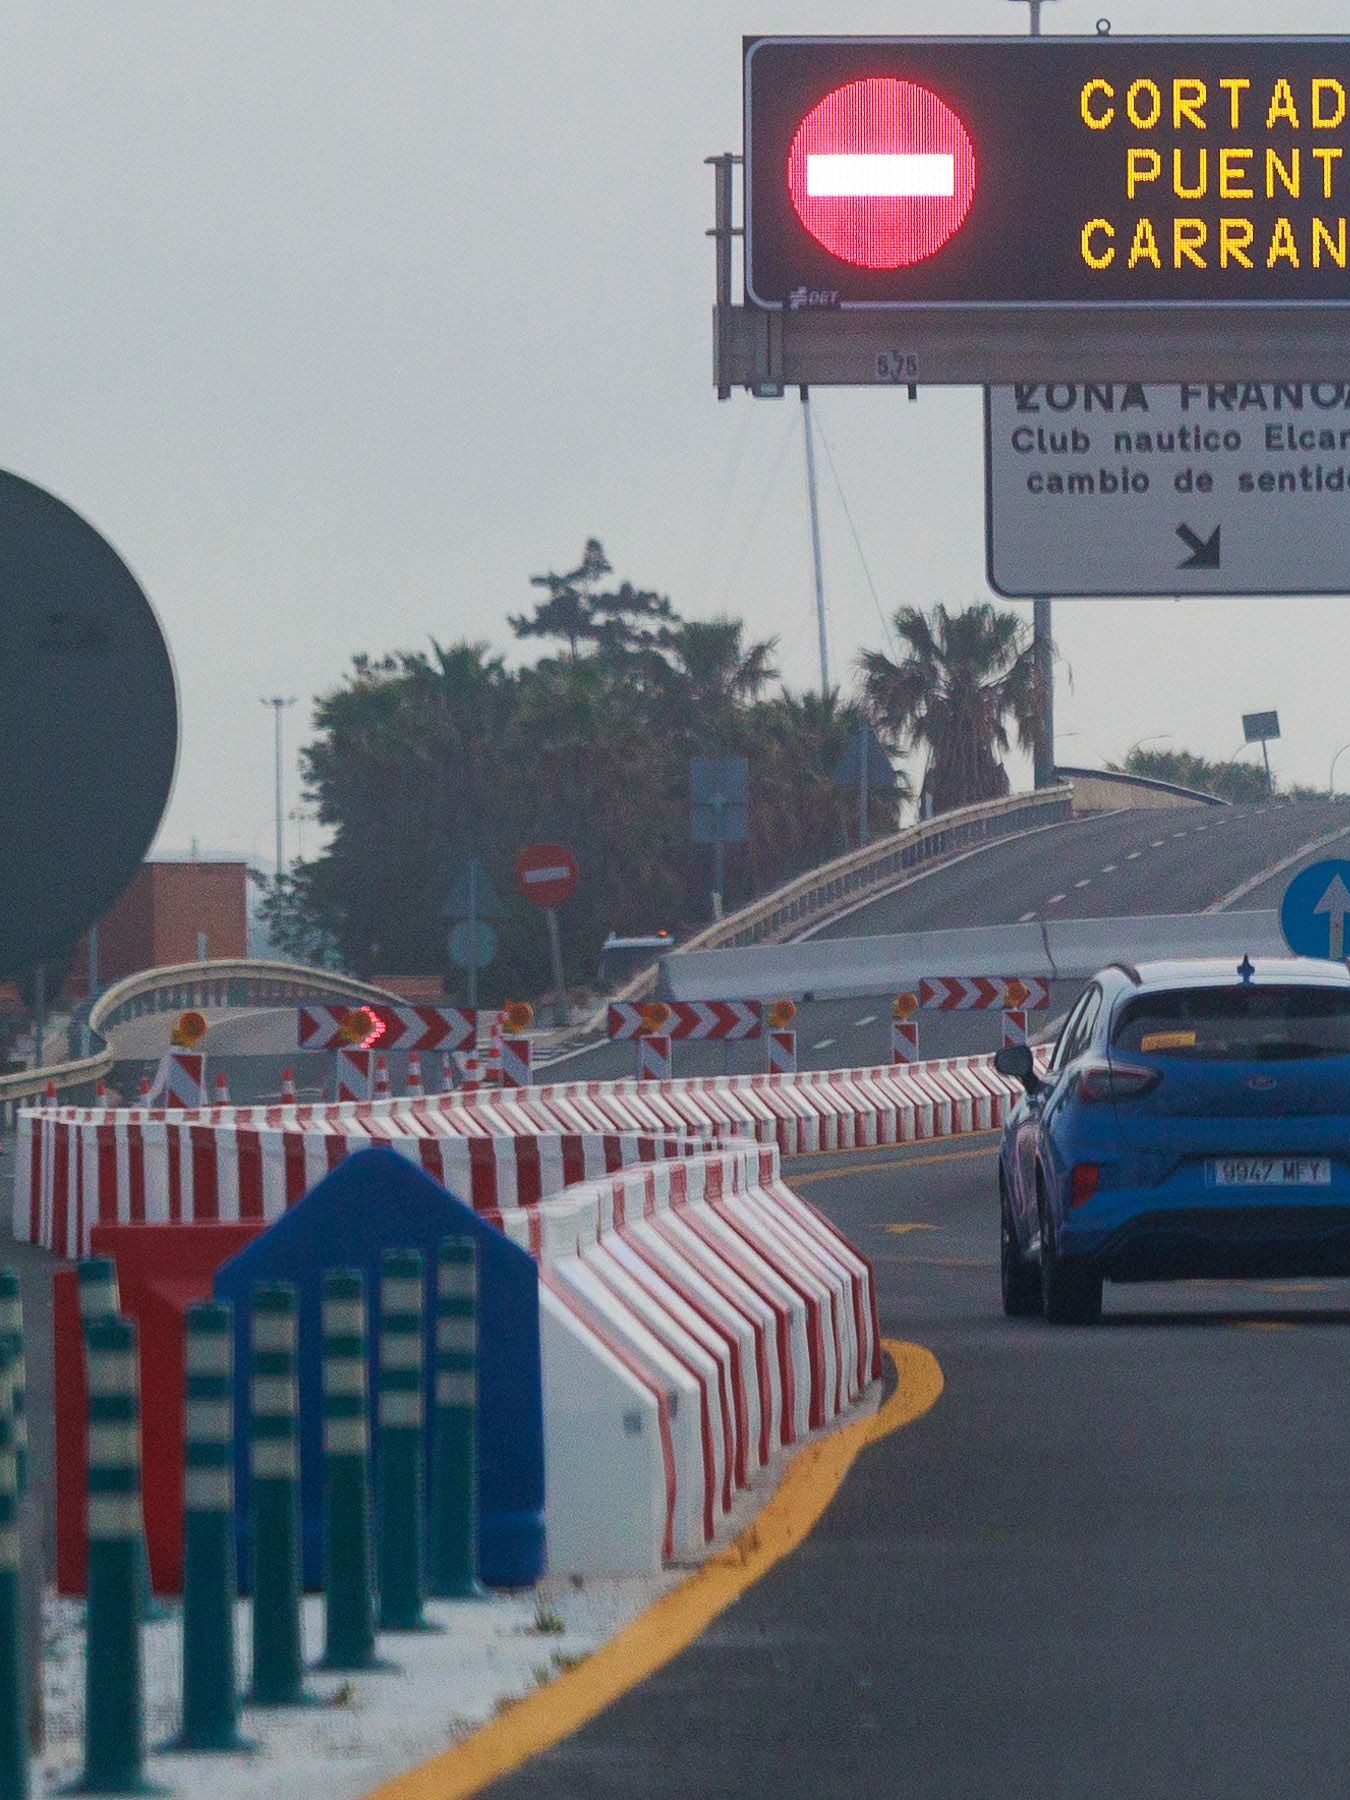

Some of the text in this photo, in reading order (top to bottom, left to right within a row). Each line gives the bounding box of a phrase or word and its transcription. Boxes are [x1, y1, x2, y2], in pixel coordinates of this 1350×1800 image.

[1014, 382, 1149, 413] ZONA
[1011, 425, 1091, 454] Club
[1113, 424, 1242, 452] nautico
[1027, 466, 1151, 495] cambio
[1173, 465, 1214, 493] de
